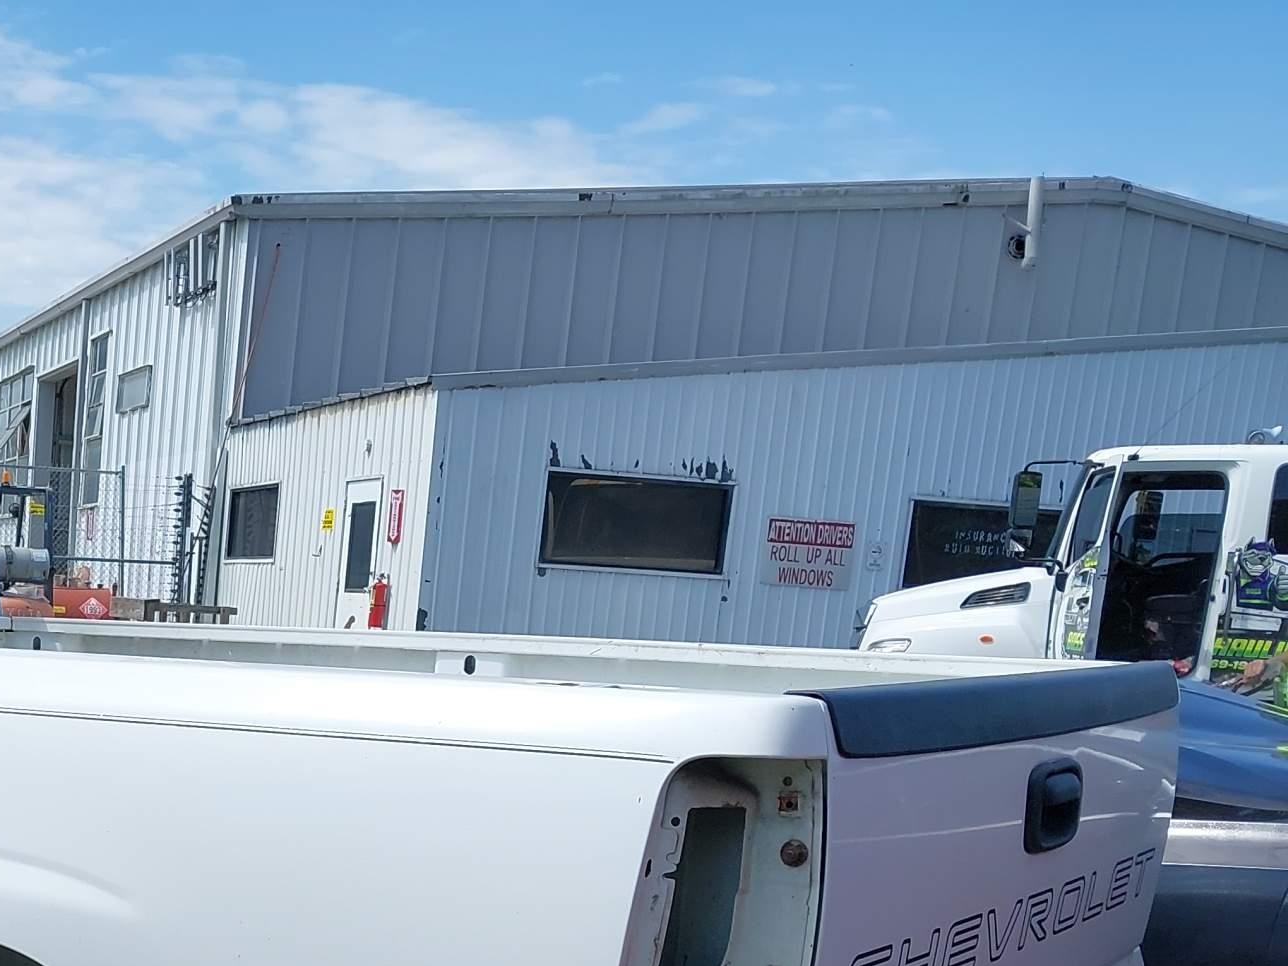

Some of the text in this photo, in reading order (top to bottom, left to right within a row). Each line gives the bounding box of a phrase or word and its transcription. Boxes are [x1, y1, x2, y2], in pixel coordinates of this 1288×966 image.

[769, 521, 853, 547] ATTENTION DRIVERS
[955, 530, 1009, 543] INSURANC
[771, 545, 846, 566] ROLL UP ALL
[778, 567, 834, 587] WINDOWS
